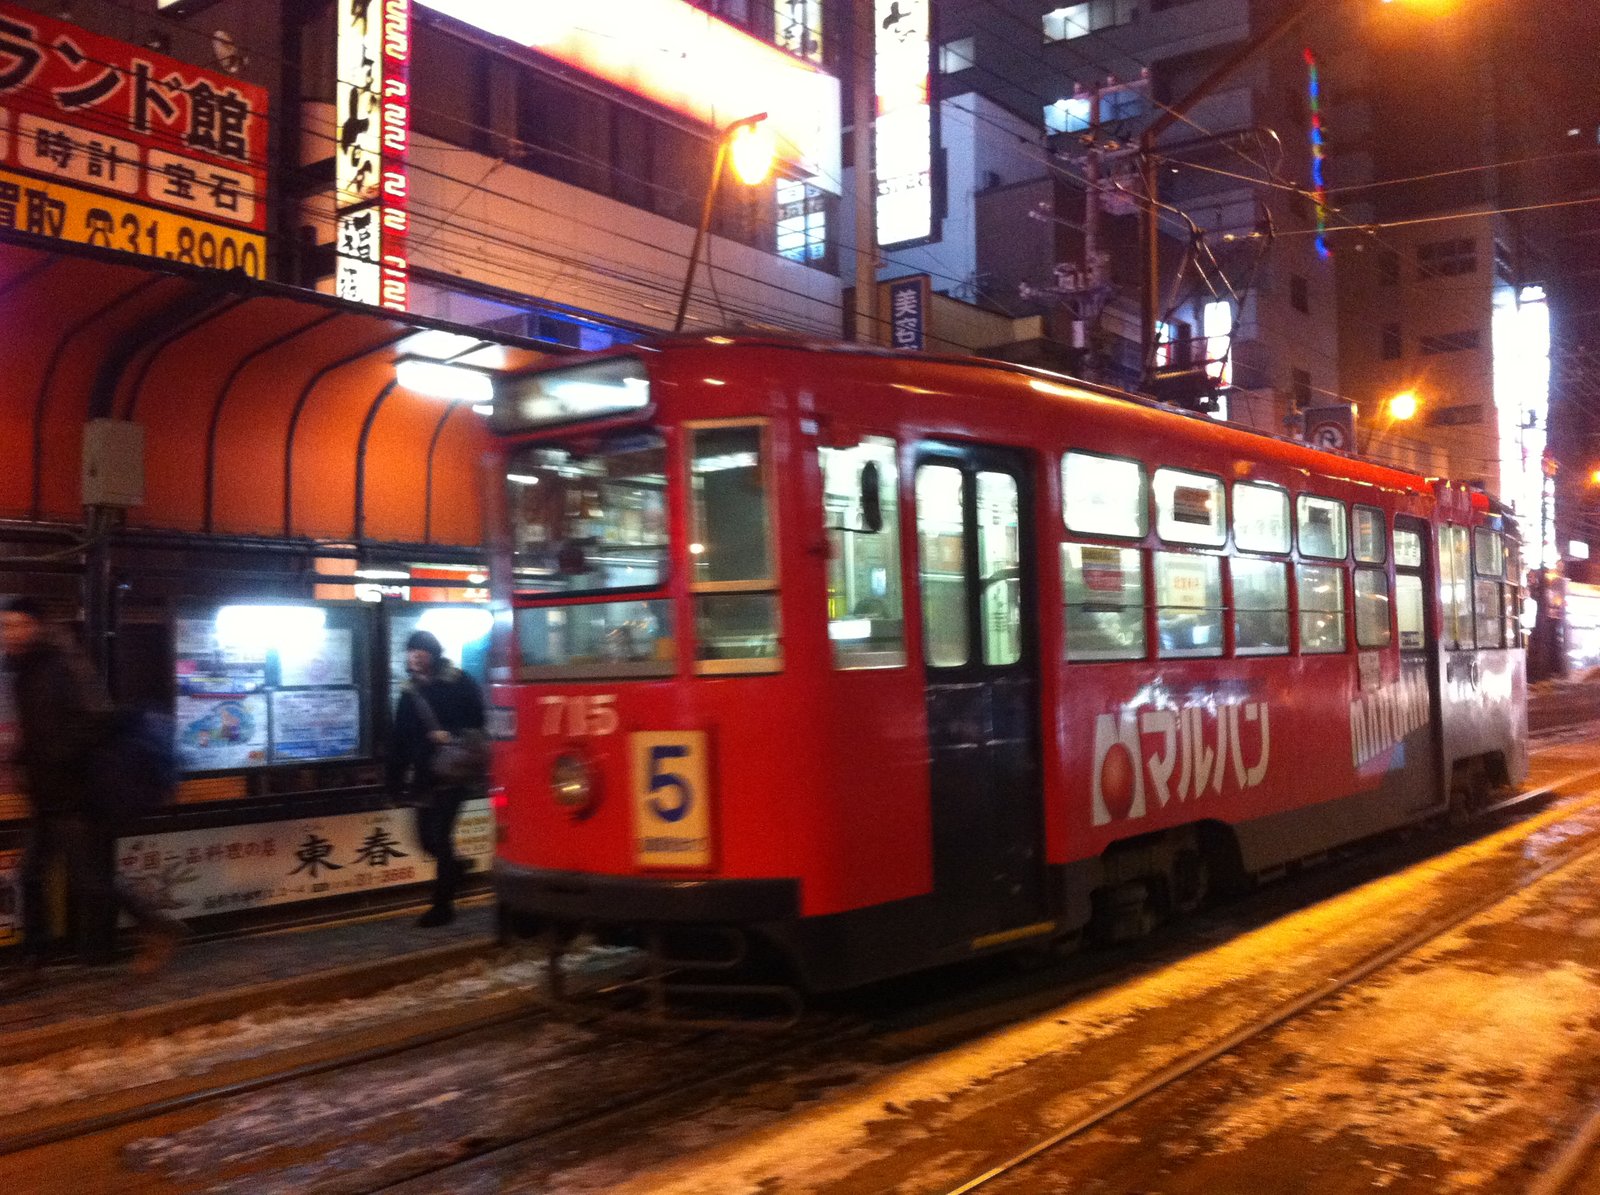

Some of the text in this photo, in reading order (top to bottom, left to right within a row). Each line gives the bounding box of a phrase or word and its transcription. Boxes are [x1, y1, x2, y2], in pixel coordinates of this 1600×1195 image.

[35, 128, 242, 212] 時計 宝石
[537, 694, 620, 736] 715
[1141, 702, 1271, 808] マルハン
[648, 743, 692, 823] 5
[286, 827, 409, 878] 東春
